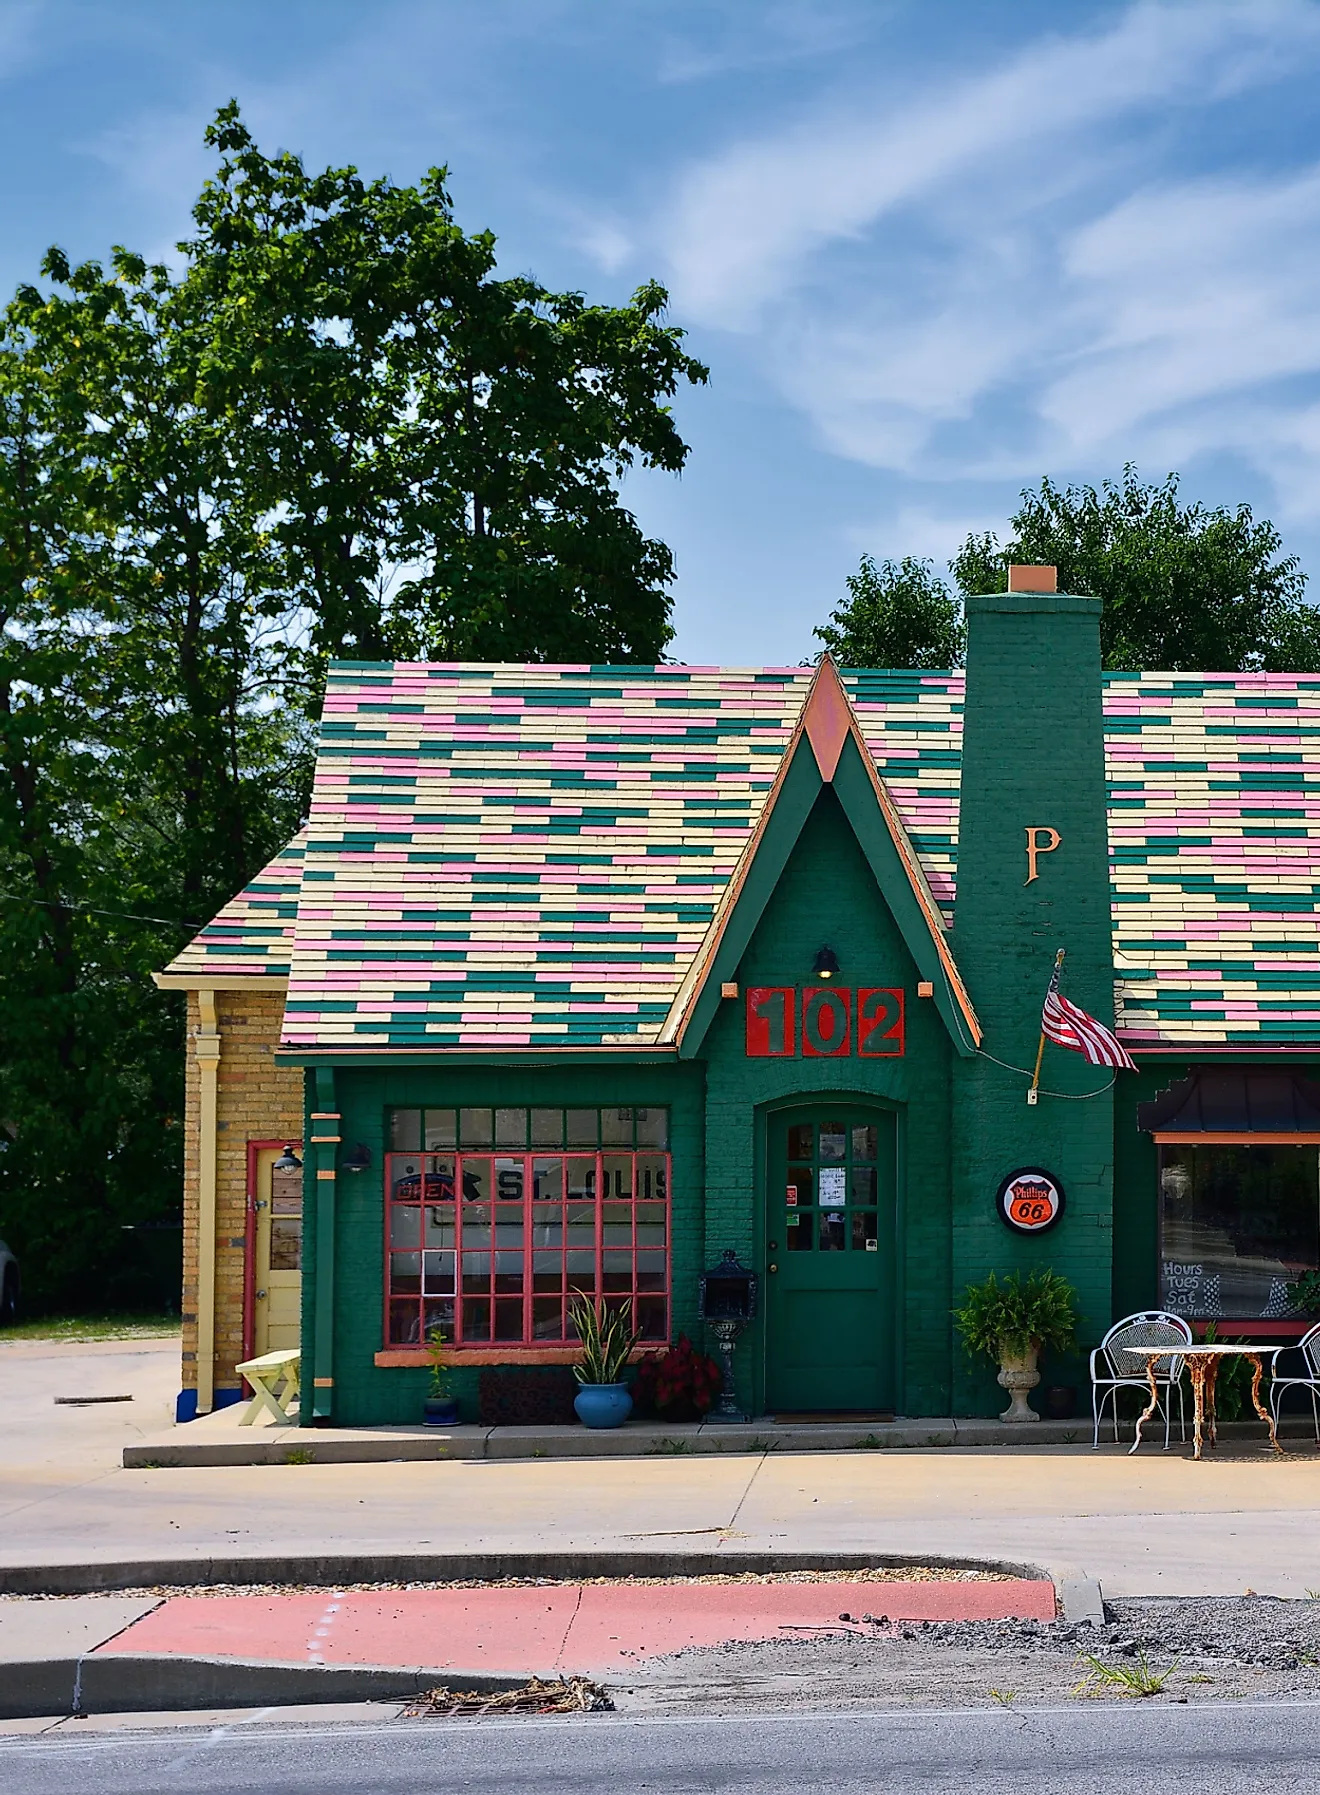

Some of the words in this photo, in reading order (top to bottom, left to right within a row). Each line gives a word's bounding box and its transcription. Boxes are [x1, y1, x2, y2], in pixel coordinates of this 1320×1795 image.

[1023, 827, 1062, 887] P
[757, 992, 900, 1053] 102
[397, 1183, 457, 1199] OPEN
[1014, 1186, 1047, 1200] Phillips
[1019, 1202, 1044, 1219] 66
[1163, 1262, 1202, 1275] Hours
[1167, 1276, 1199, 1289] Tues
[1166, 1291, 1196, 1305] Sat
